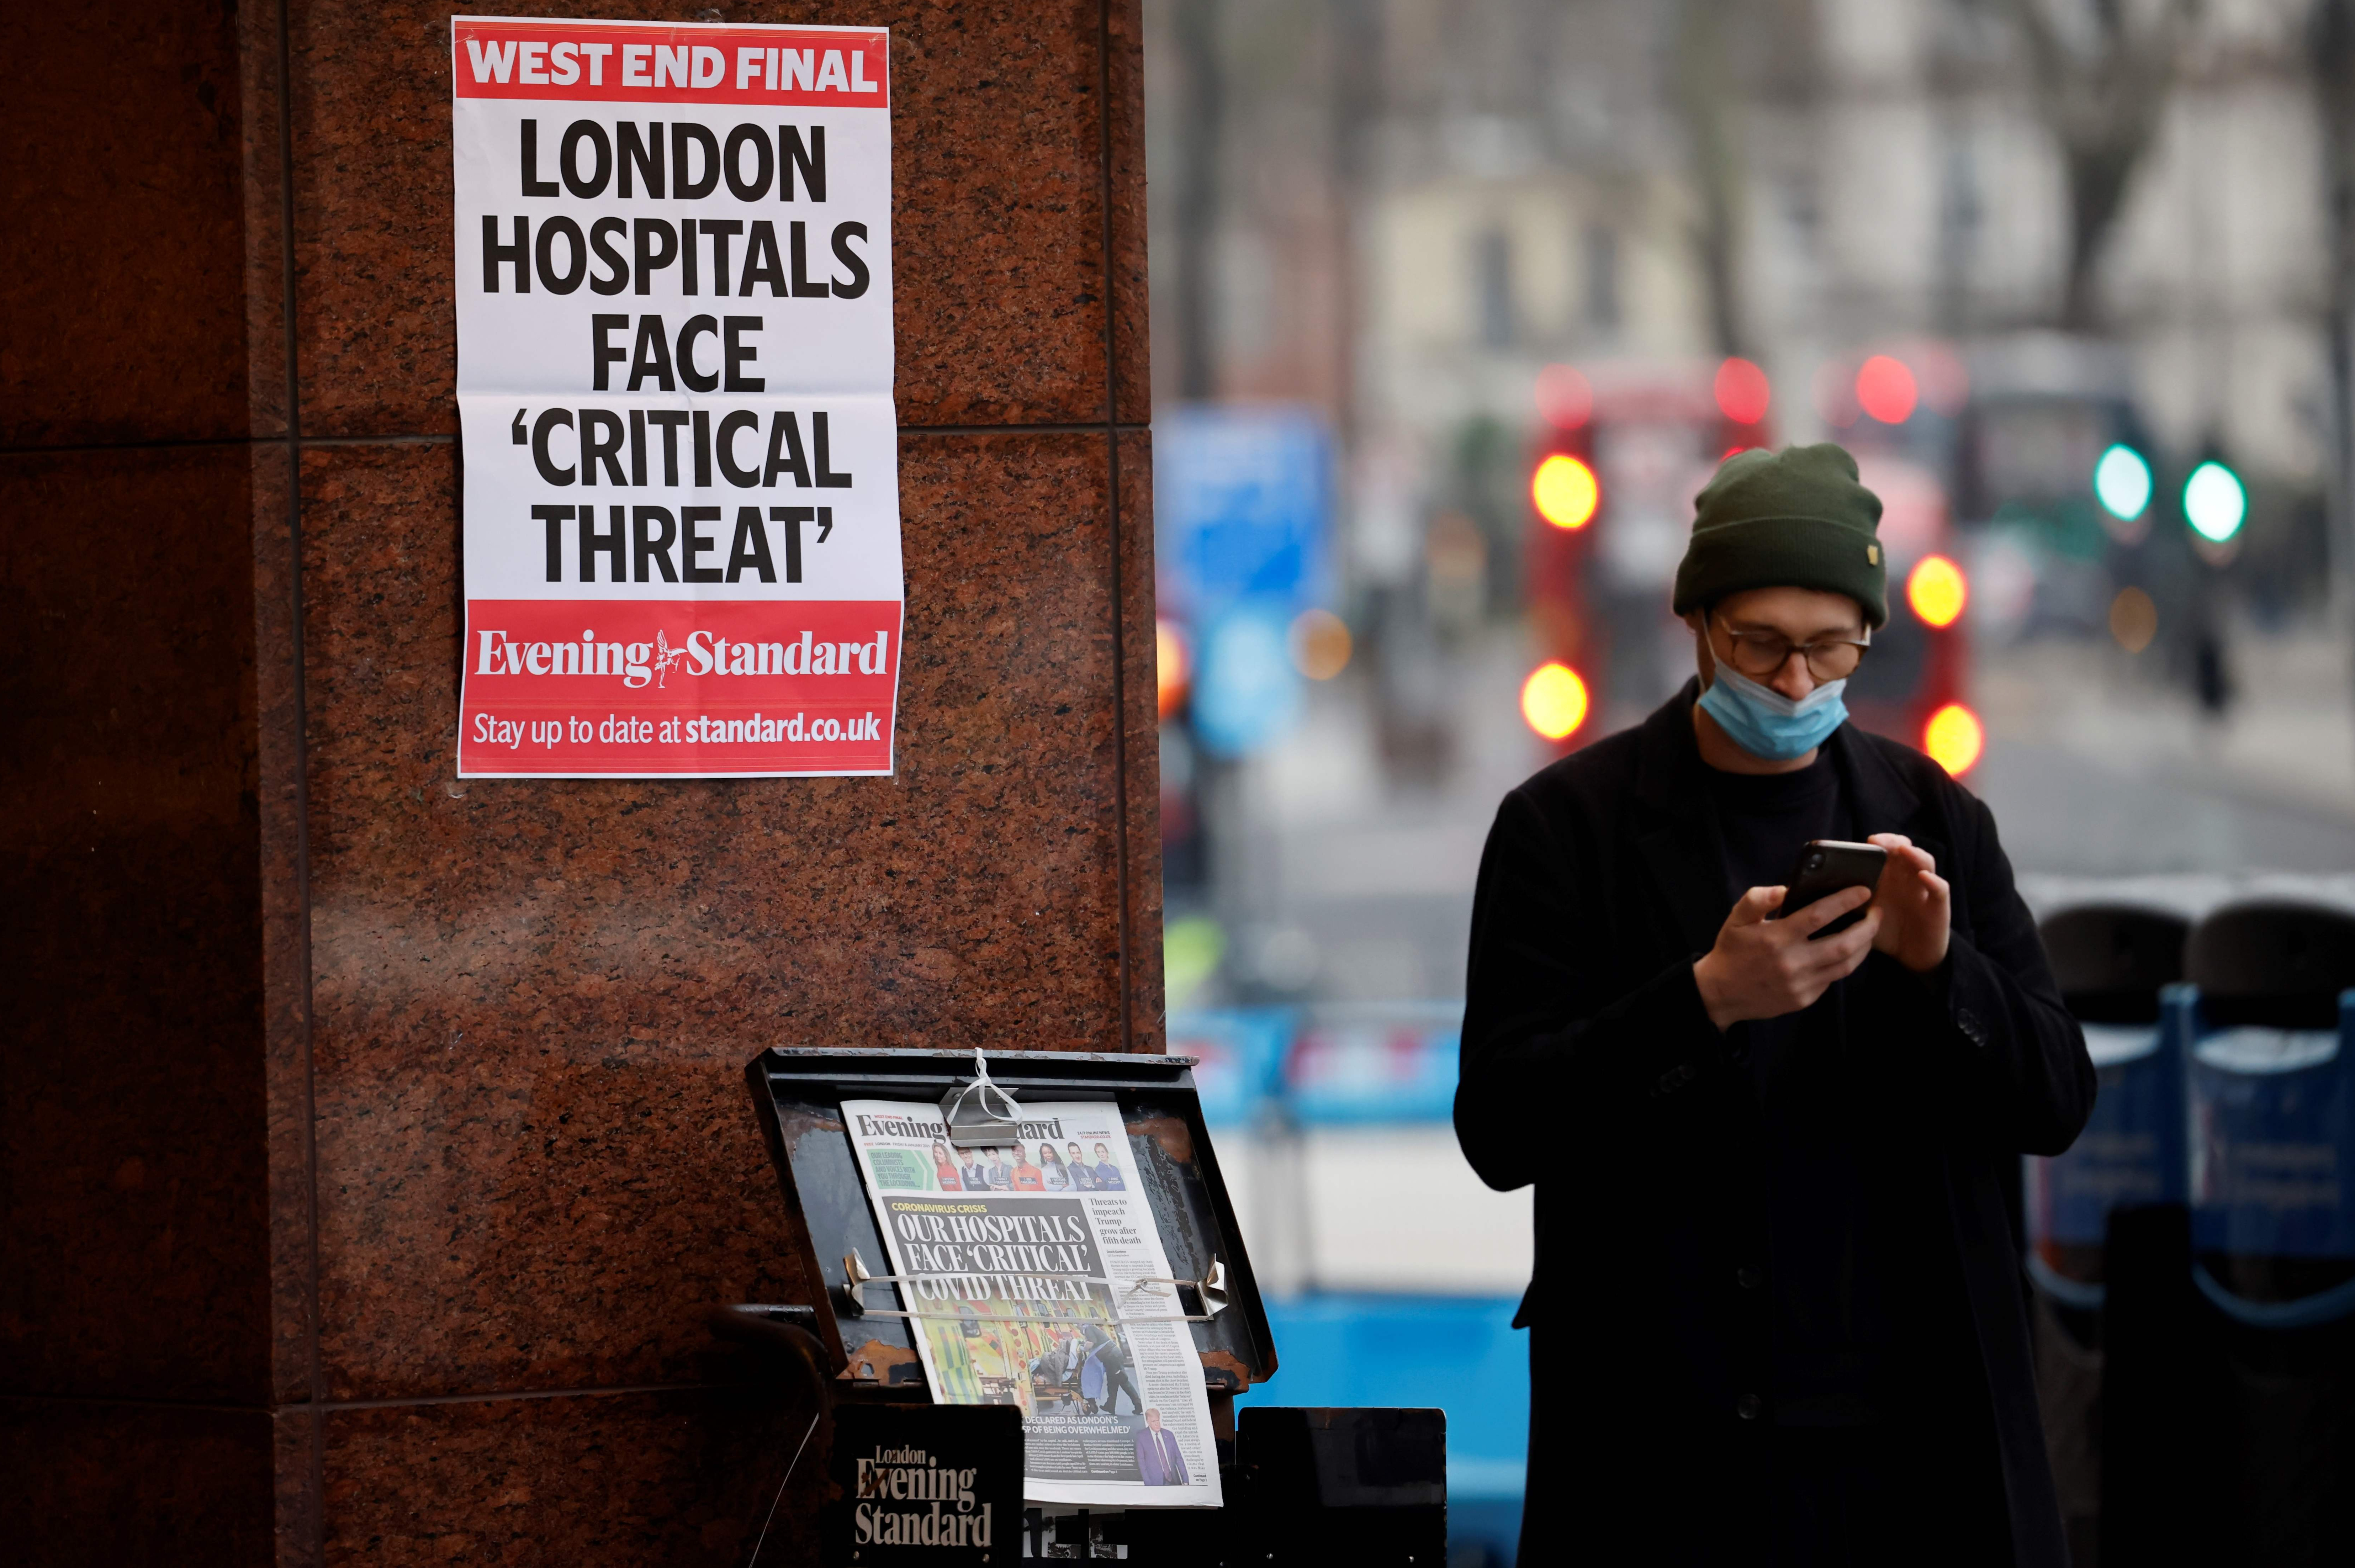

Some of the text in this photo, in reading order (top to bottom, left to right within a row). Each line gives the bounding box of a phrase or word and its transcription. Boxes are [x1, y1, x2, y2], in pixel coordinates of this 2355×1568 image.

[466, 40, 878, 93] WEST END FINAL
[520, 118, 826, 203] LONDON
[482, 214, 870, 299] HOSPITALS
[591, 313, 766, 393] FACE
[474, 629, 889, 688] Evening Standard
[473, 712, 881, 749] Stay up to date at standard.co.uk
[856, 1115, 946, 1144] Evening
[891, 1202, 987, 1213] CORONAVIRUS CRISIS
[1092, 1208, 1126, 1217] impeach
[1095, 1218, 1122, 1226] Trump
[898, 1213, 1085, 1243] OUR HOSPITALS
[904, 1243, 969, 1271] FACE
[916, 1273, 991, 1301] COVID
[991, 1274, 1093, 1301] THREAT
[1044, 1426, 1067, 1434] BEING
[876, 1444, 926, 1464] London
[856, 1456, 977, 1513] Evening
[856, 1501, 992, 1547] Standard
